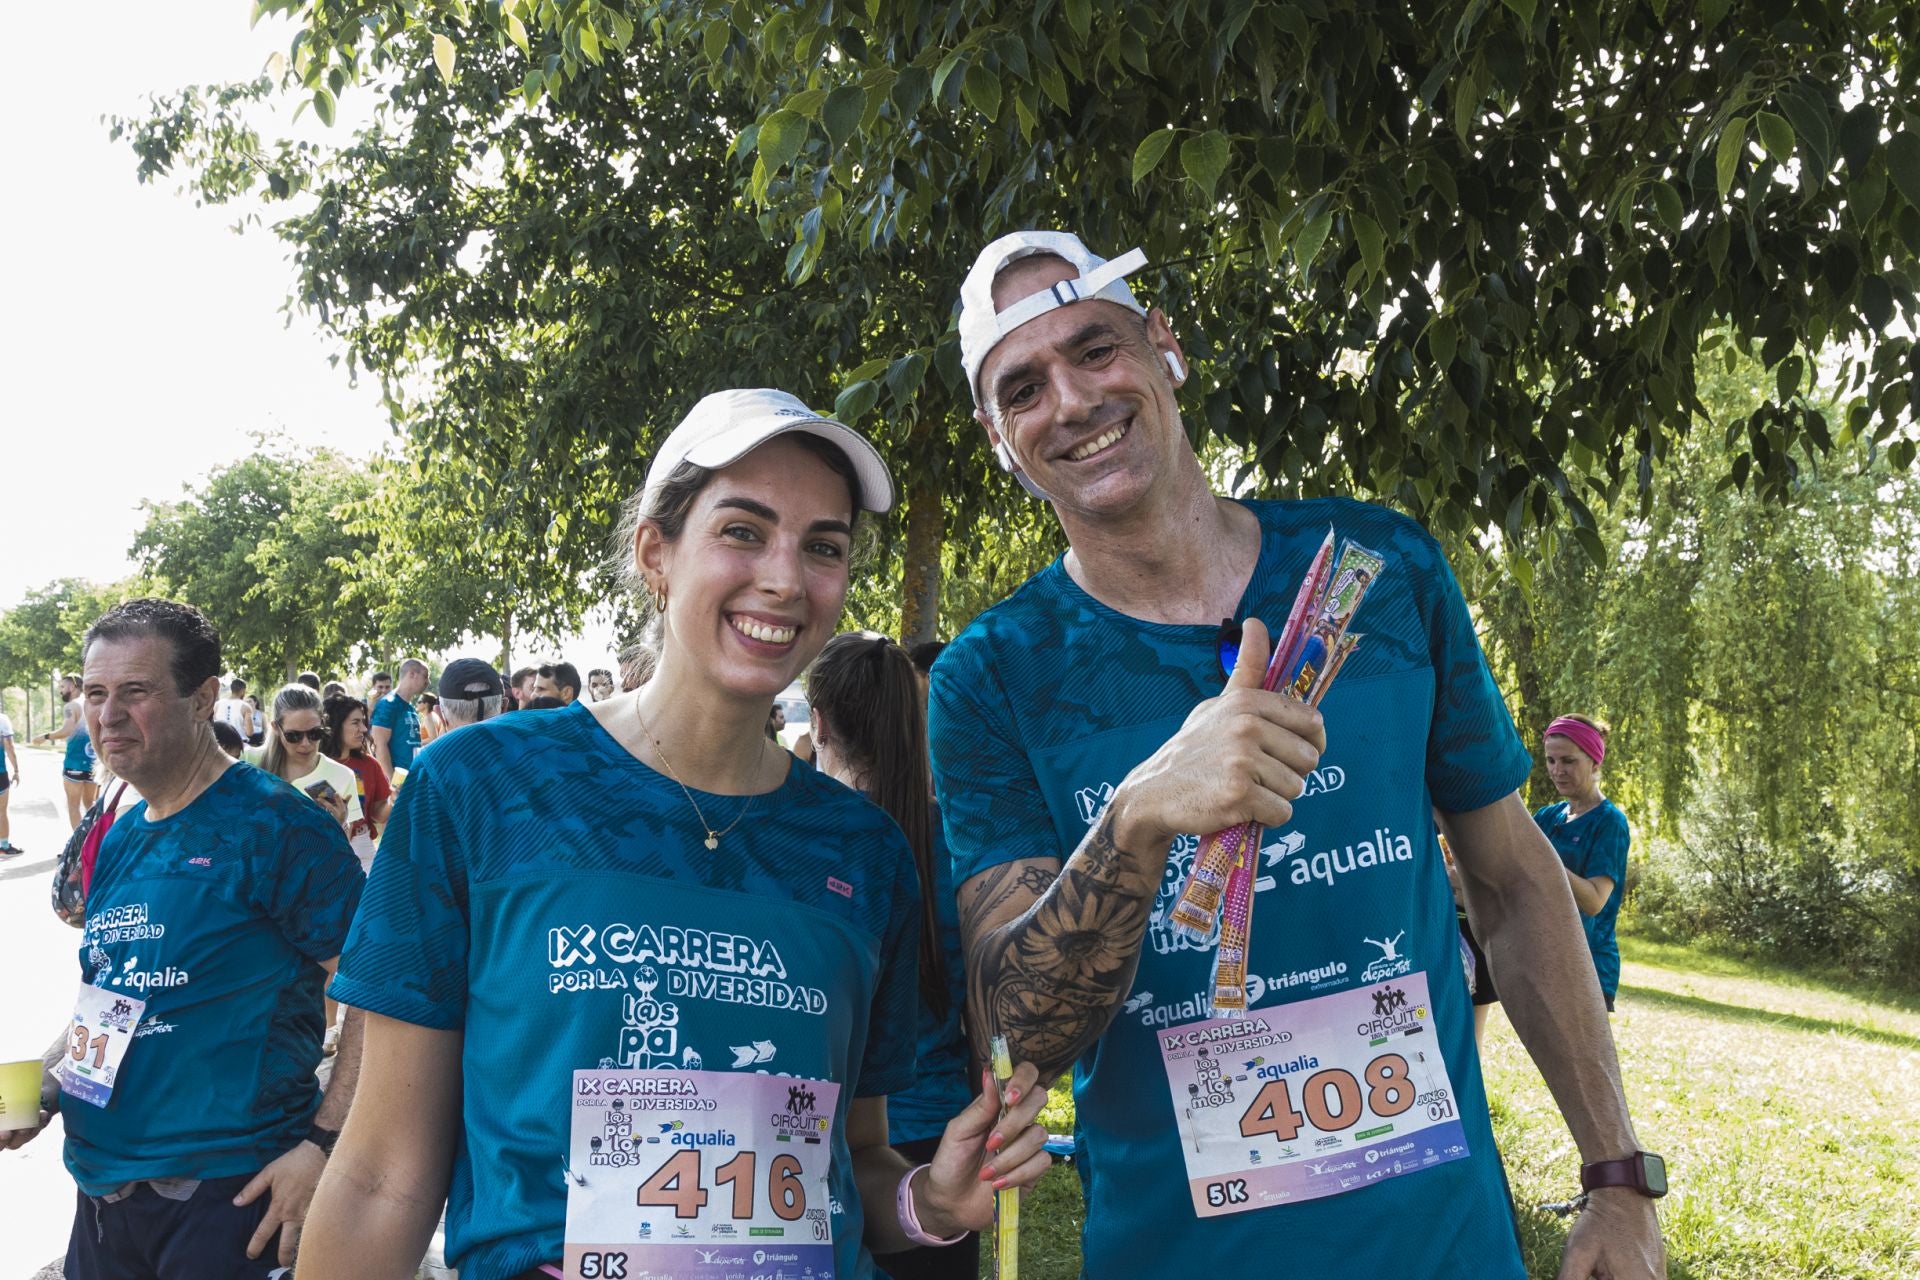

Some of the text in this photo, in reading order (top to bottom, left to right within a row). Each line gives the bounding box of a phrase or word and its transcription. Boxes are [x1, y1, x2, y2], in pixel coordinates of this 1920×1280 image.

[1075, 782, 1114, 824] IX
[1291, 828, 1413, 887] aqualia
[102, 924, 165, 944] DIVERDAD
[548, 923, 788, 980] IX CARRERA
[1267, 961, 1347, 991] triángulo
[549, 969, 828, 1015] POR LA DIVERSIDAD
[622, 994, 679, 1028] l@s
[1141, 991, 1207, 1029] aquali
[619, 1026, 677, 1066] pa
[1163, 1018, 1271, 1051] IX CARRERA
[1213, 1031, 1293, 1055] DIVERSIDAD
[1194, 1058, 1219, 1070] l@s
[1256, 1055, 1319, 1080] aqualia
[577, 1077, 698, 1096] IX CARRERA
[1197, 1067, 1221, 1086] pa
[1206, 1079, 1226, 1094] lo
[577, 1098, 716, 1111] POR LA DIVERSIDAD
[1191, 1092, 1235, 1110] m@s
[1238, 1053, 1417, 1143] 408
[1417, 1088, 1448, 1106] JUNIO
[604, 1111, 632, 1123] l@s
[1427, 1099, 1454, 1121] 01
[604, 1123, 631, 1141] pa
[671, 1130, 735, 1150] aqualia
[611, 1137, 635, 1152] lo
[590, 1150, 640, 1168] m@s
[636, 1149, 806, 1221] 416
[1207, 1178, 1249, 1208] 5K
[812, 1220, 829, 1240] 01
[580, 1252, 628, 1280] 5K
